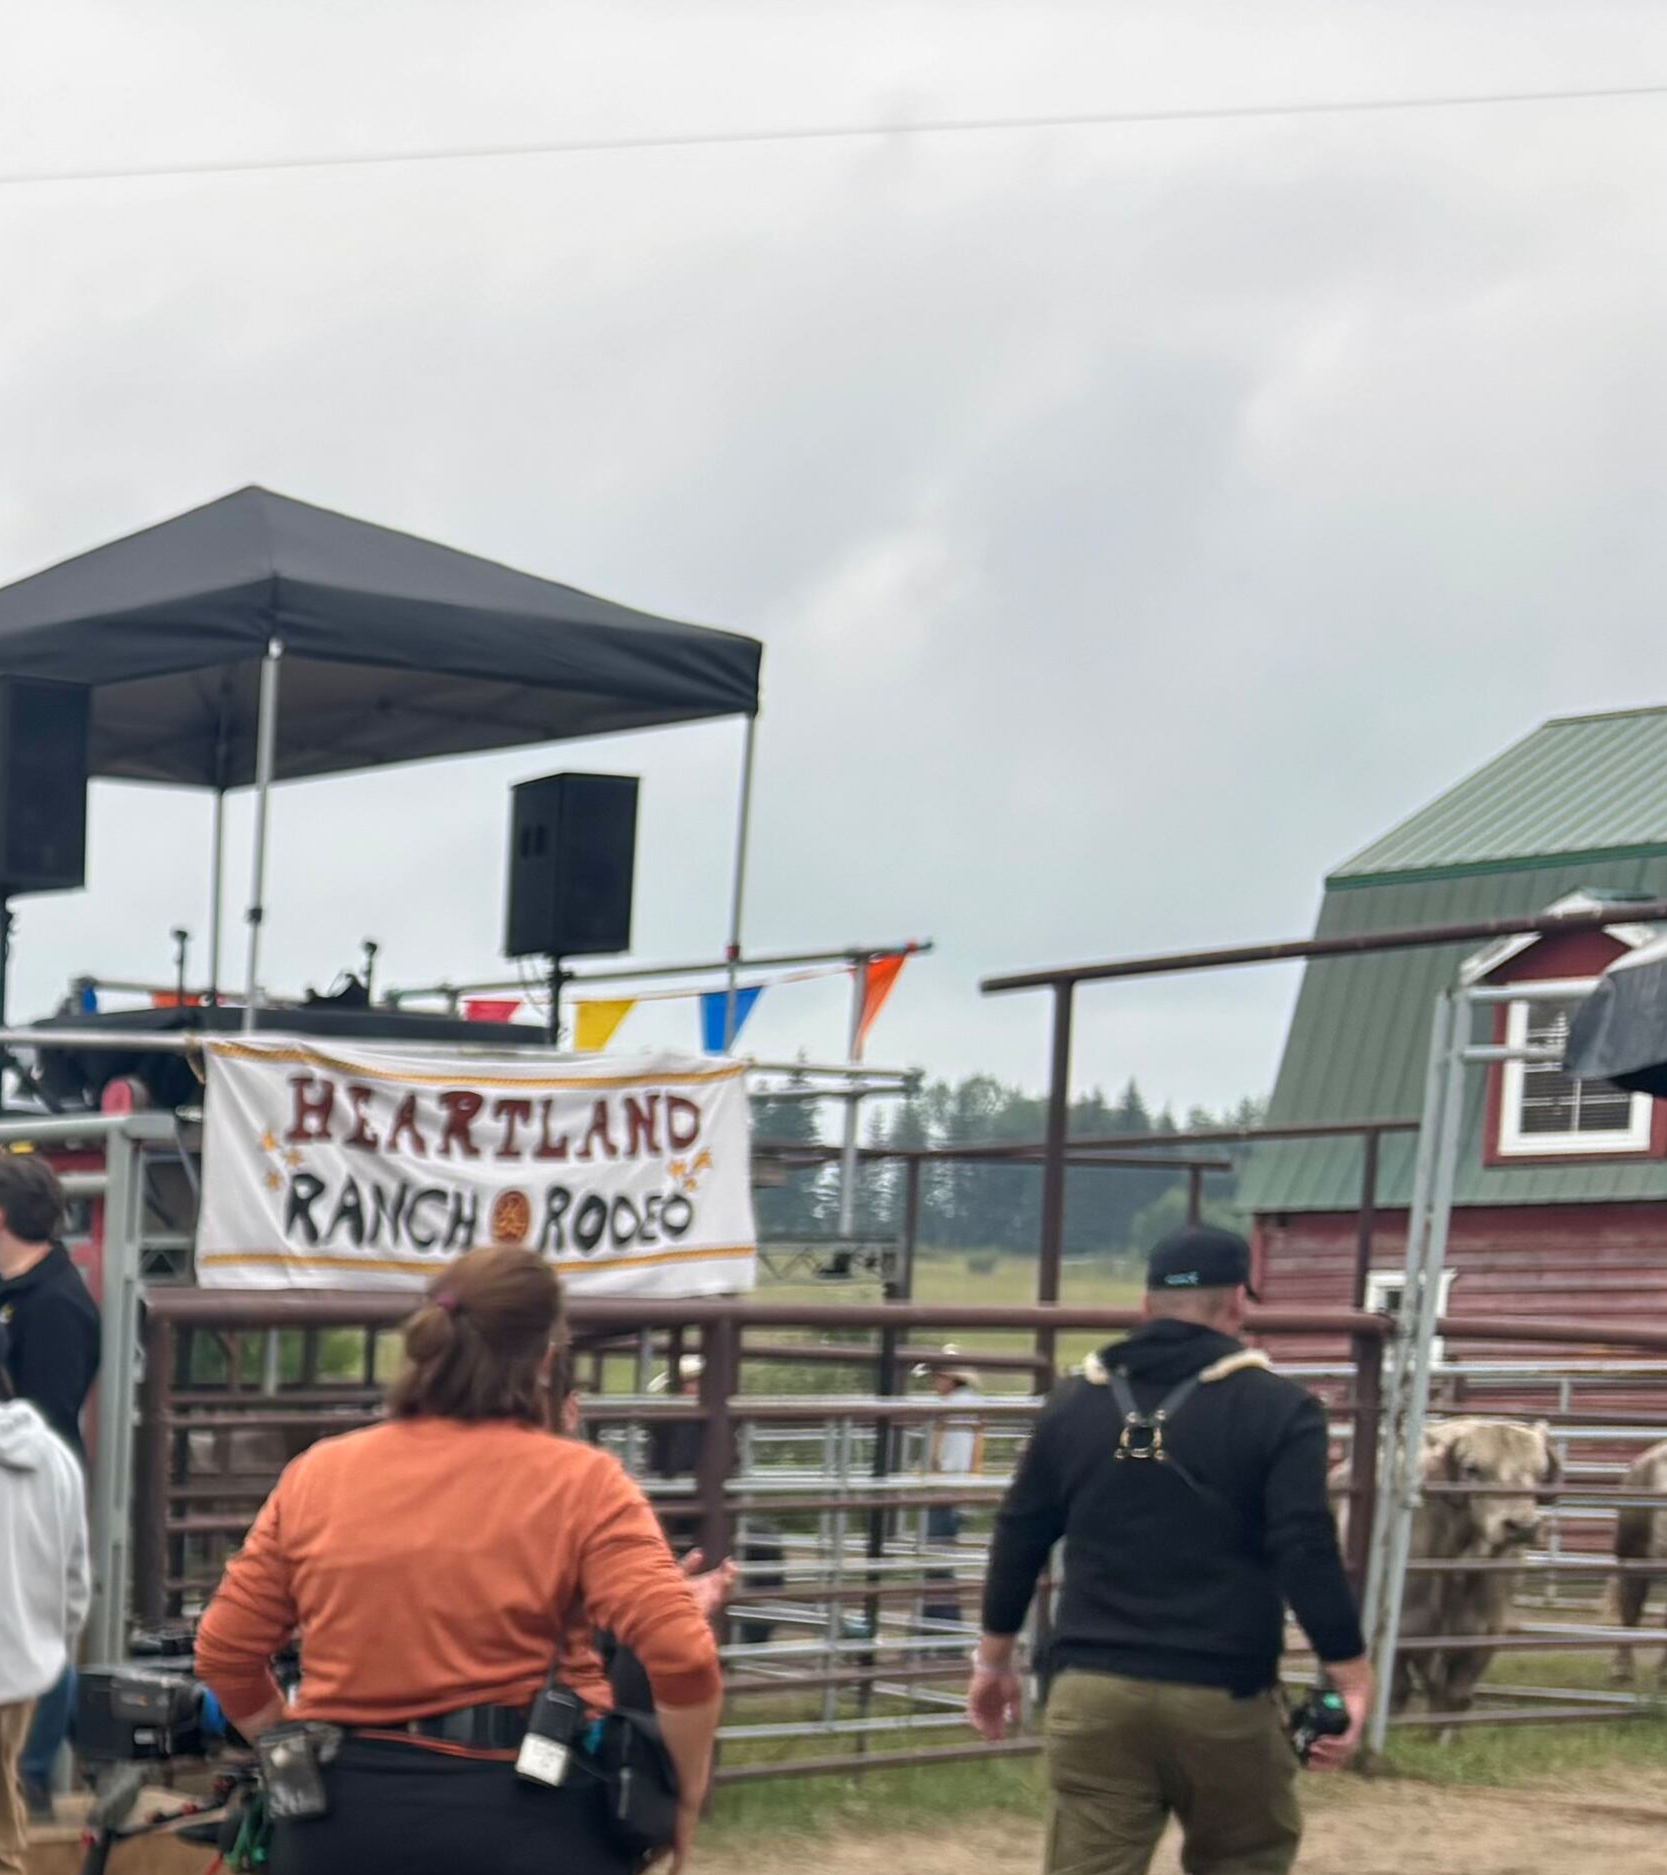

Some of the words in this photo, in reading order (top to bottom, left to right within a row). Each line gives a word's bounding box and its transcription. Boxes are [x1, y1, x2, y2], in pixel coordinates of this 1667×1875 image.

[284, 1076, 703, 1160] HEARTLAND
[283, 1171, 479, 1251] RANCH
[539, 1185, 694, 1254] RODEO
